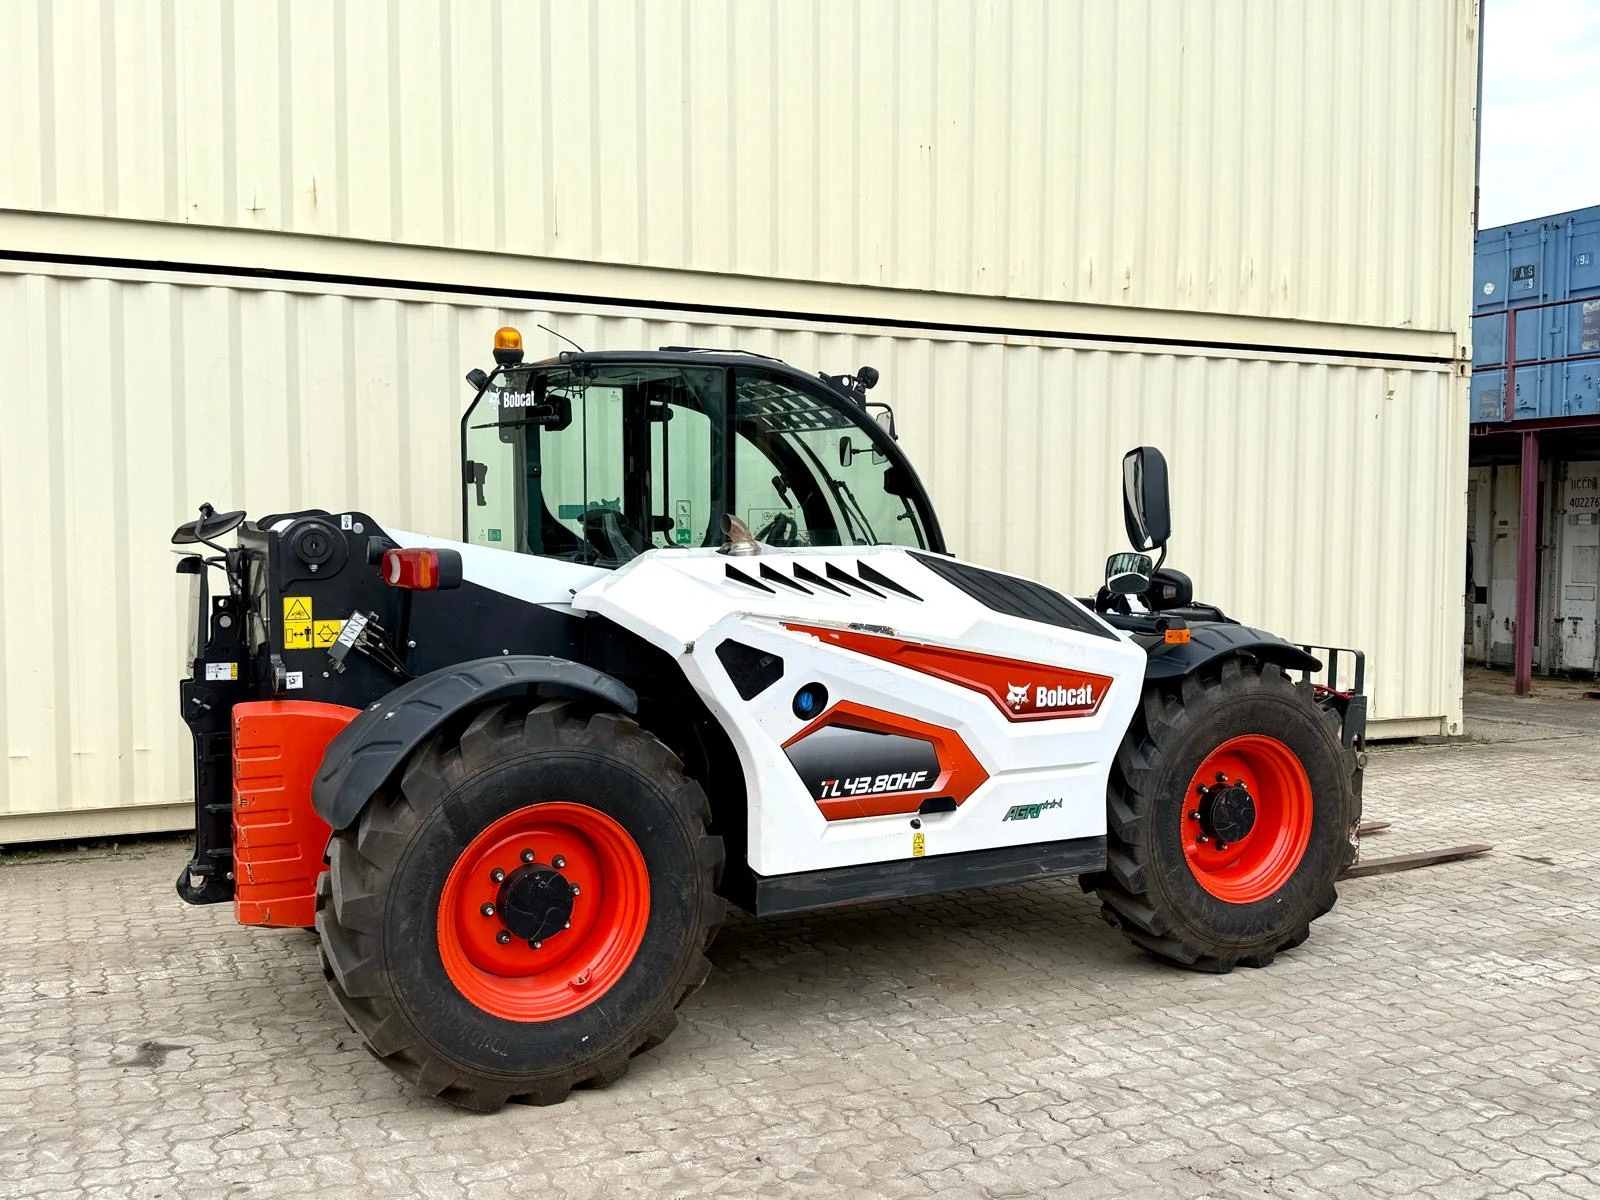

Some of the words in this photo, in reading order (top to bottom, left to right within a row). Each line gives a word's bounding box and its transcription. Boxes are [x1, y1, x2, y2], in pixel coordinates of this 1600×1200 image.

[503, 390, 535, 408] Bobcat
[1569, 497, 1600, 508] 402276
[1035, 684, 1093, 708] Bobcat
[1002, 803, 1042, 821] AGRI
